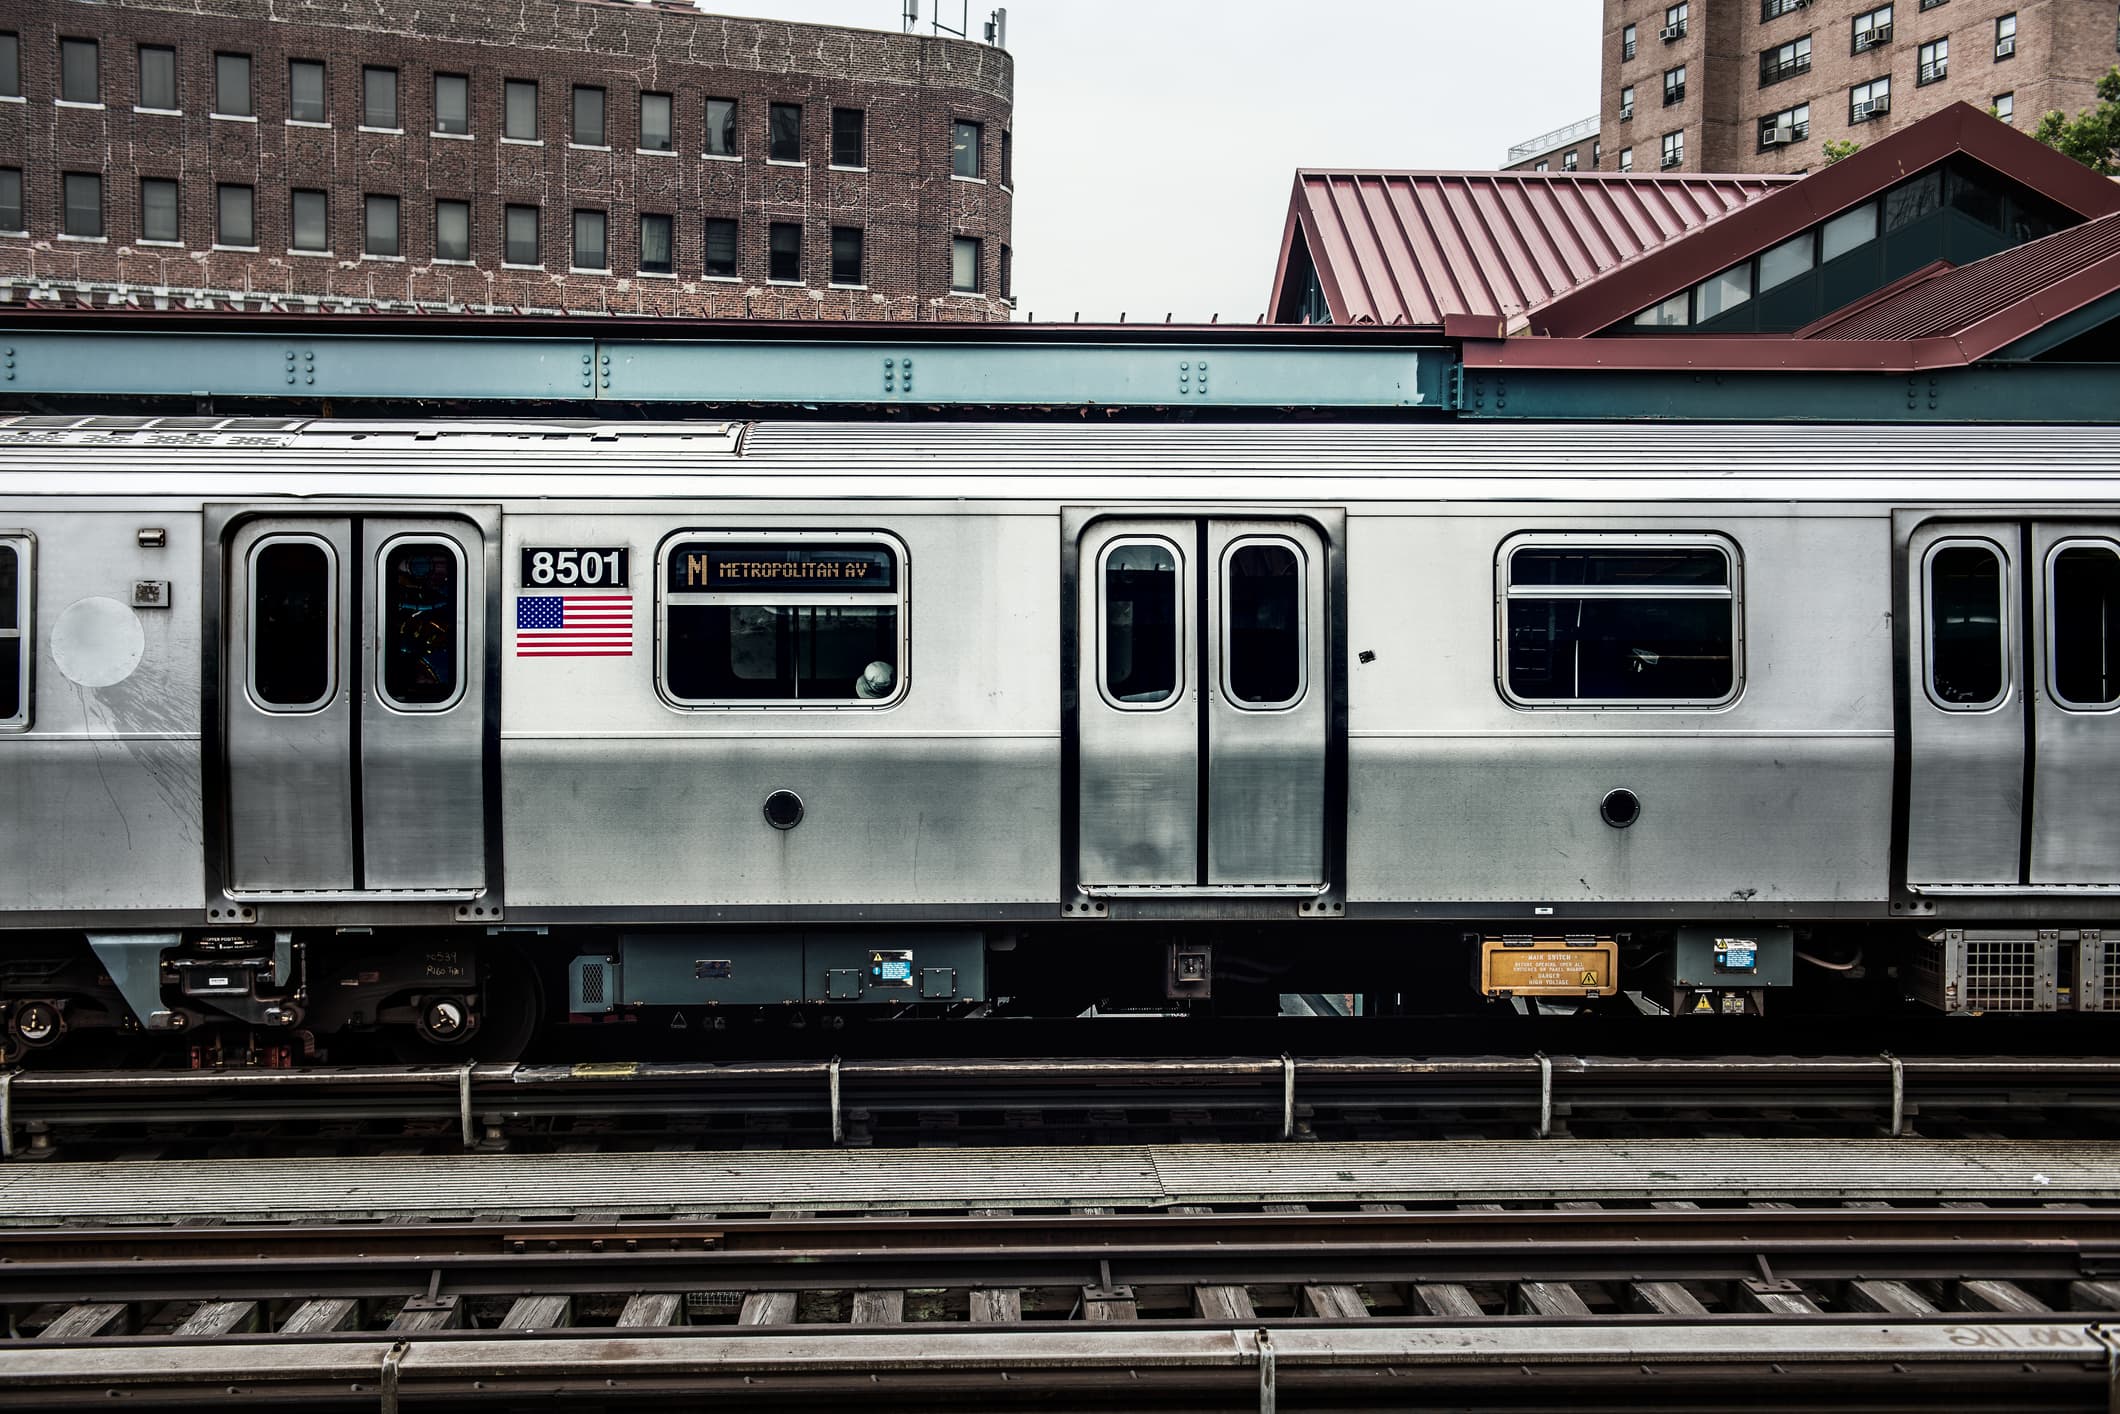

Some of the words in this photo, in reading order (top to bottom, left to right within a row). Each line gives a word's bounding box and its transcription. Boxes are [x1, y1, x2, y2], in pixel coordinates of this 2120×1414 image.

[531, 551, 619, 584] 8501
[687, 554, 708, 586] M
[719, 562, 840, 578] METROPOLITAN
[845, 562, 868, 578] AV
